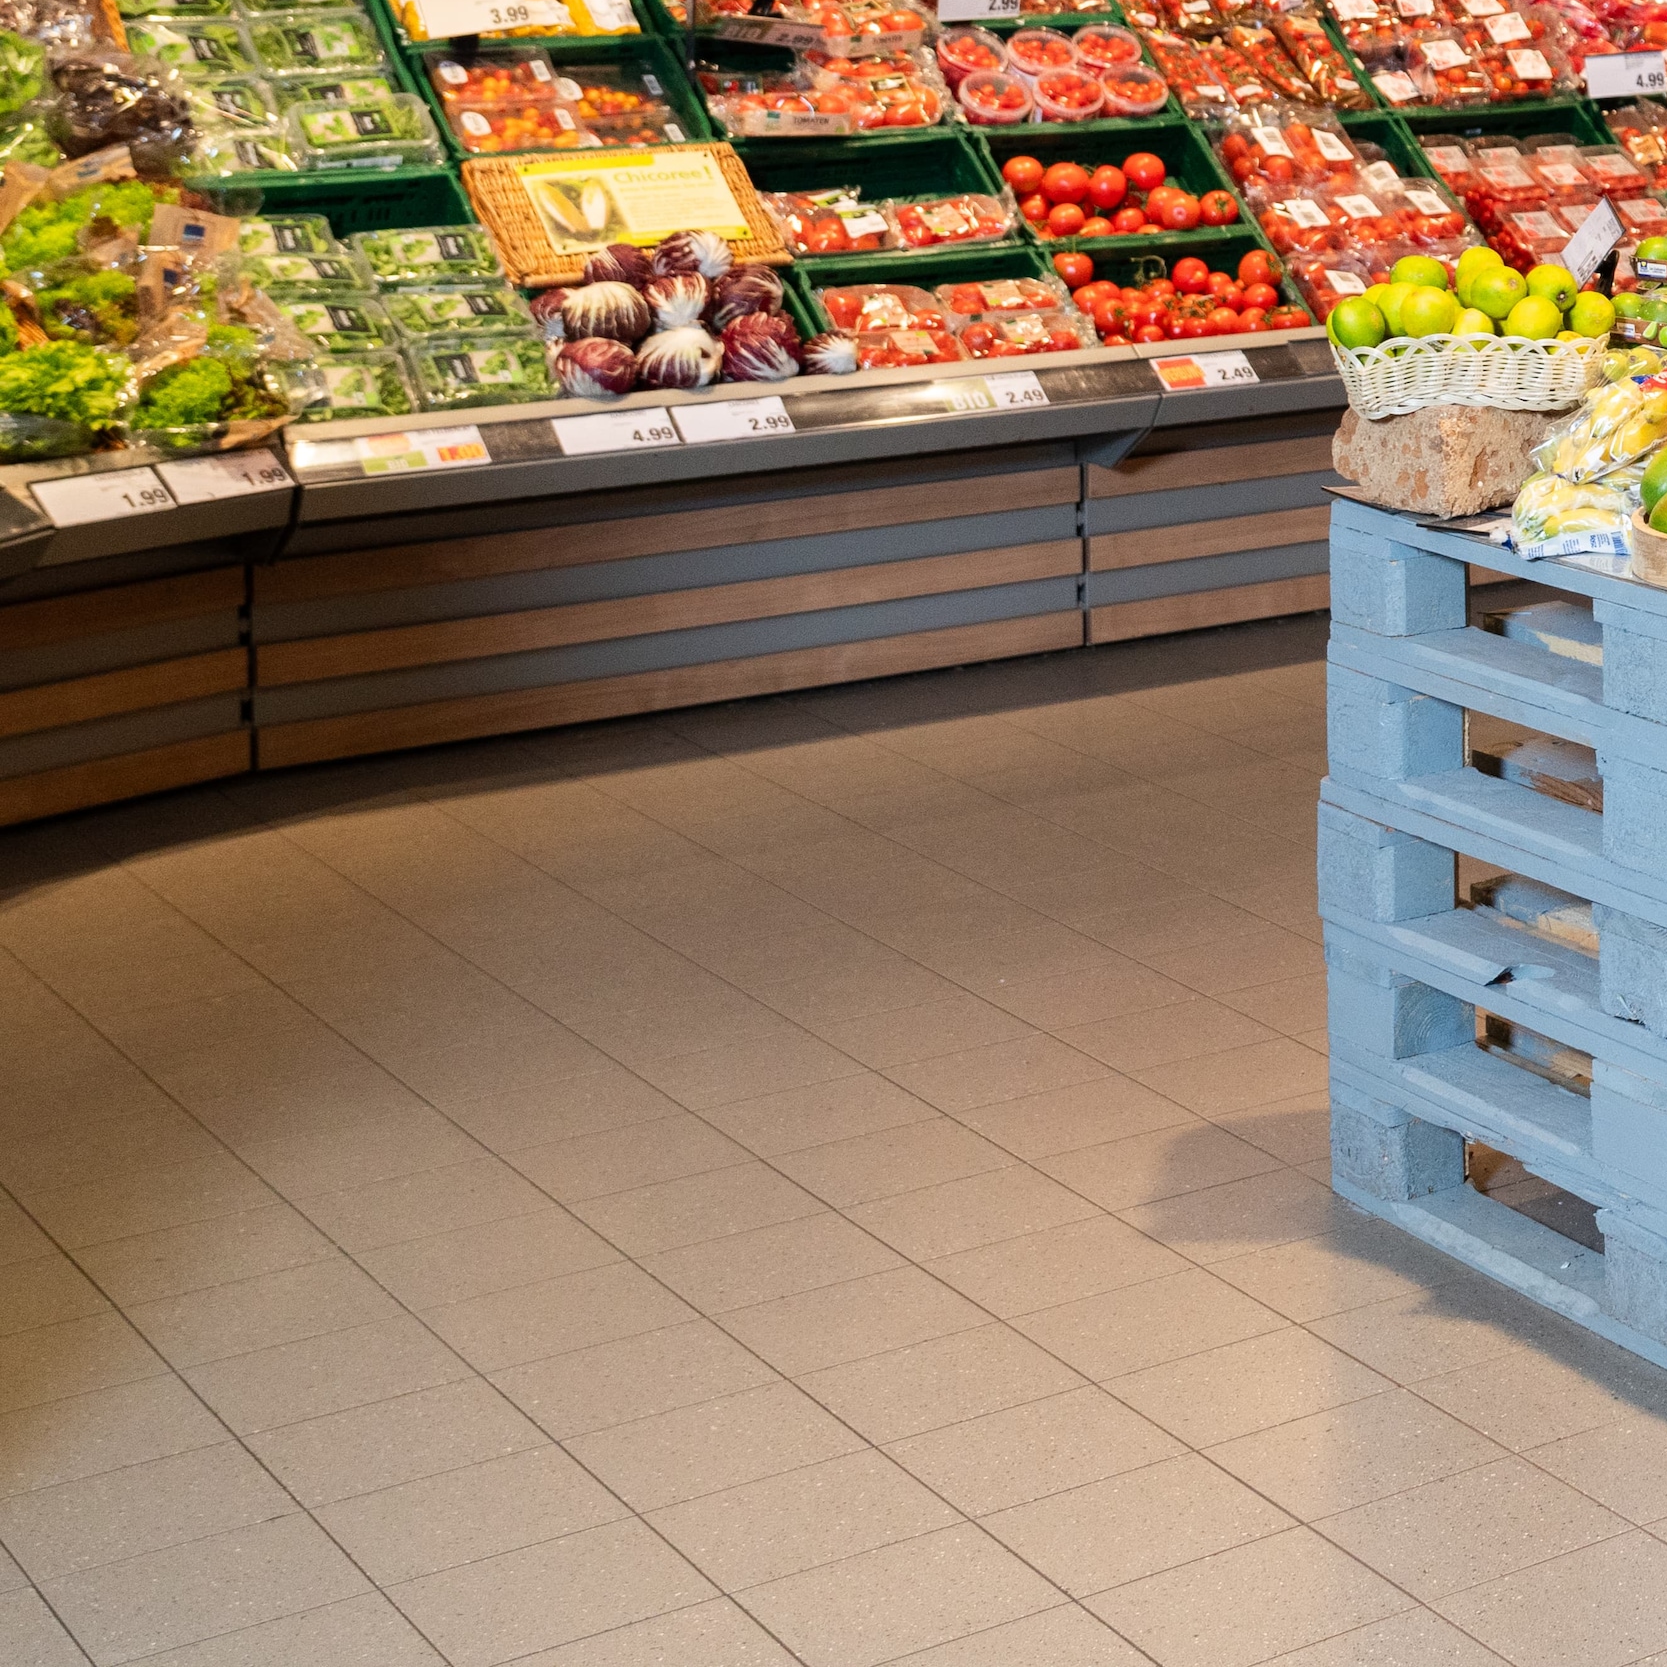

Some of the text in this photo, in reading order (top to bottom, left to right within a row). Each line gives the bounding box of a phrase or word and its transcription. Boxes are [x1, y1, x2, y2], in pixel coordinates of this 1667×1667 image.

[490, 5, 529, 25] 3.99
[1636, 72, 1664, 88] 4.99
[1217, 365, 1254, 382] 2.49
[953, 390, 990, 410] BIO
[1006, 389, 1045, 405] 2.49
[748, 415, 790, 431] 2.99
[632, 427, 674, 442] 4.99
[241, 466, 288, 487] 1.99
[122, 488, 169, 508] 1.99
